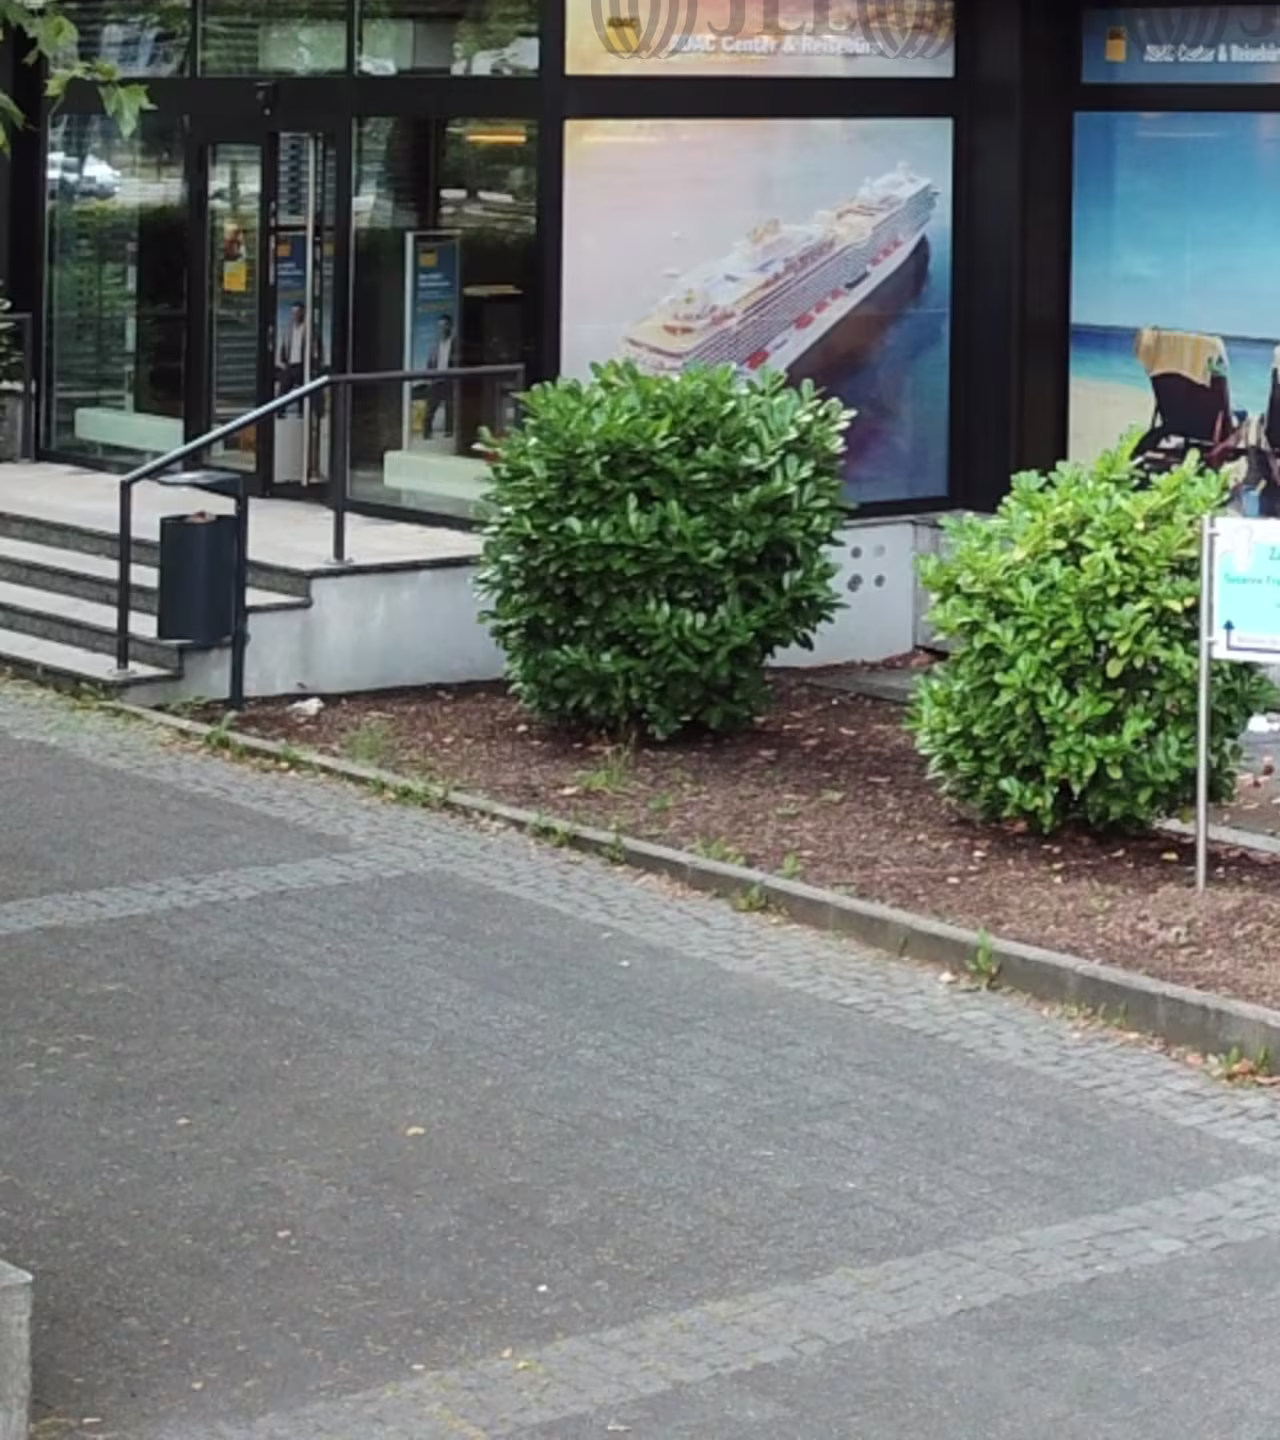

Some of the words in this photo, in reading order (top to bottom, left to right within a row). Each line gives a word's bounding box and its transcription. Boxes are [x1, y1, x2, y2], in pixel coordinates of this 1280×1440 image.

[671, 34, 716, 53] ADAC
[721, 35, 777, 54] Center
[783, 36, 796, 53] &
